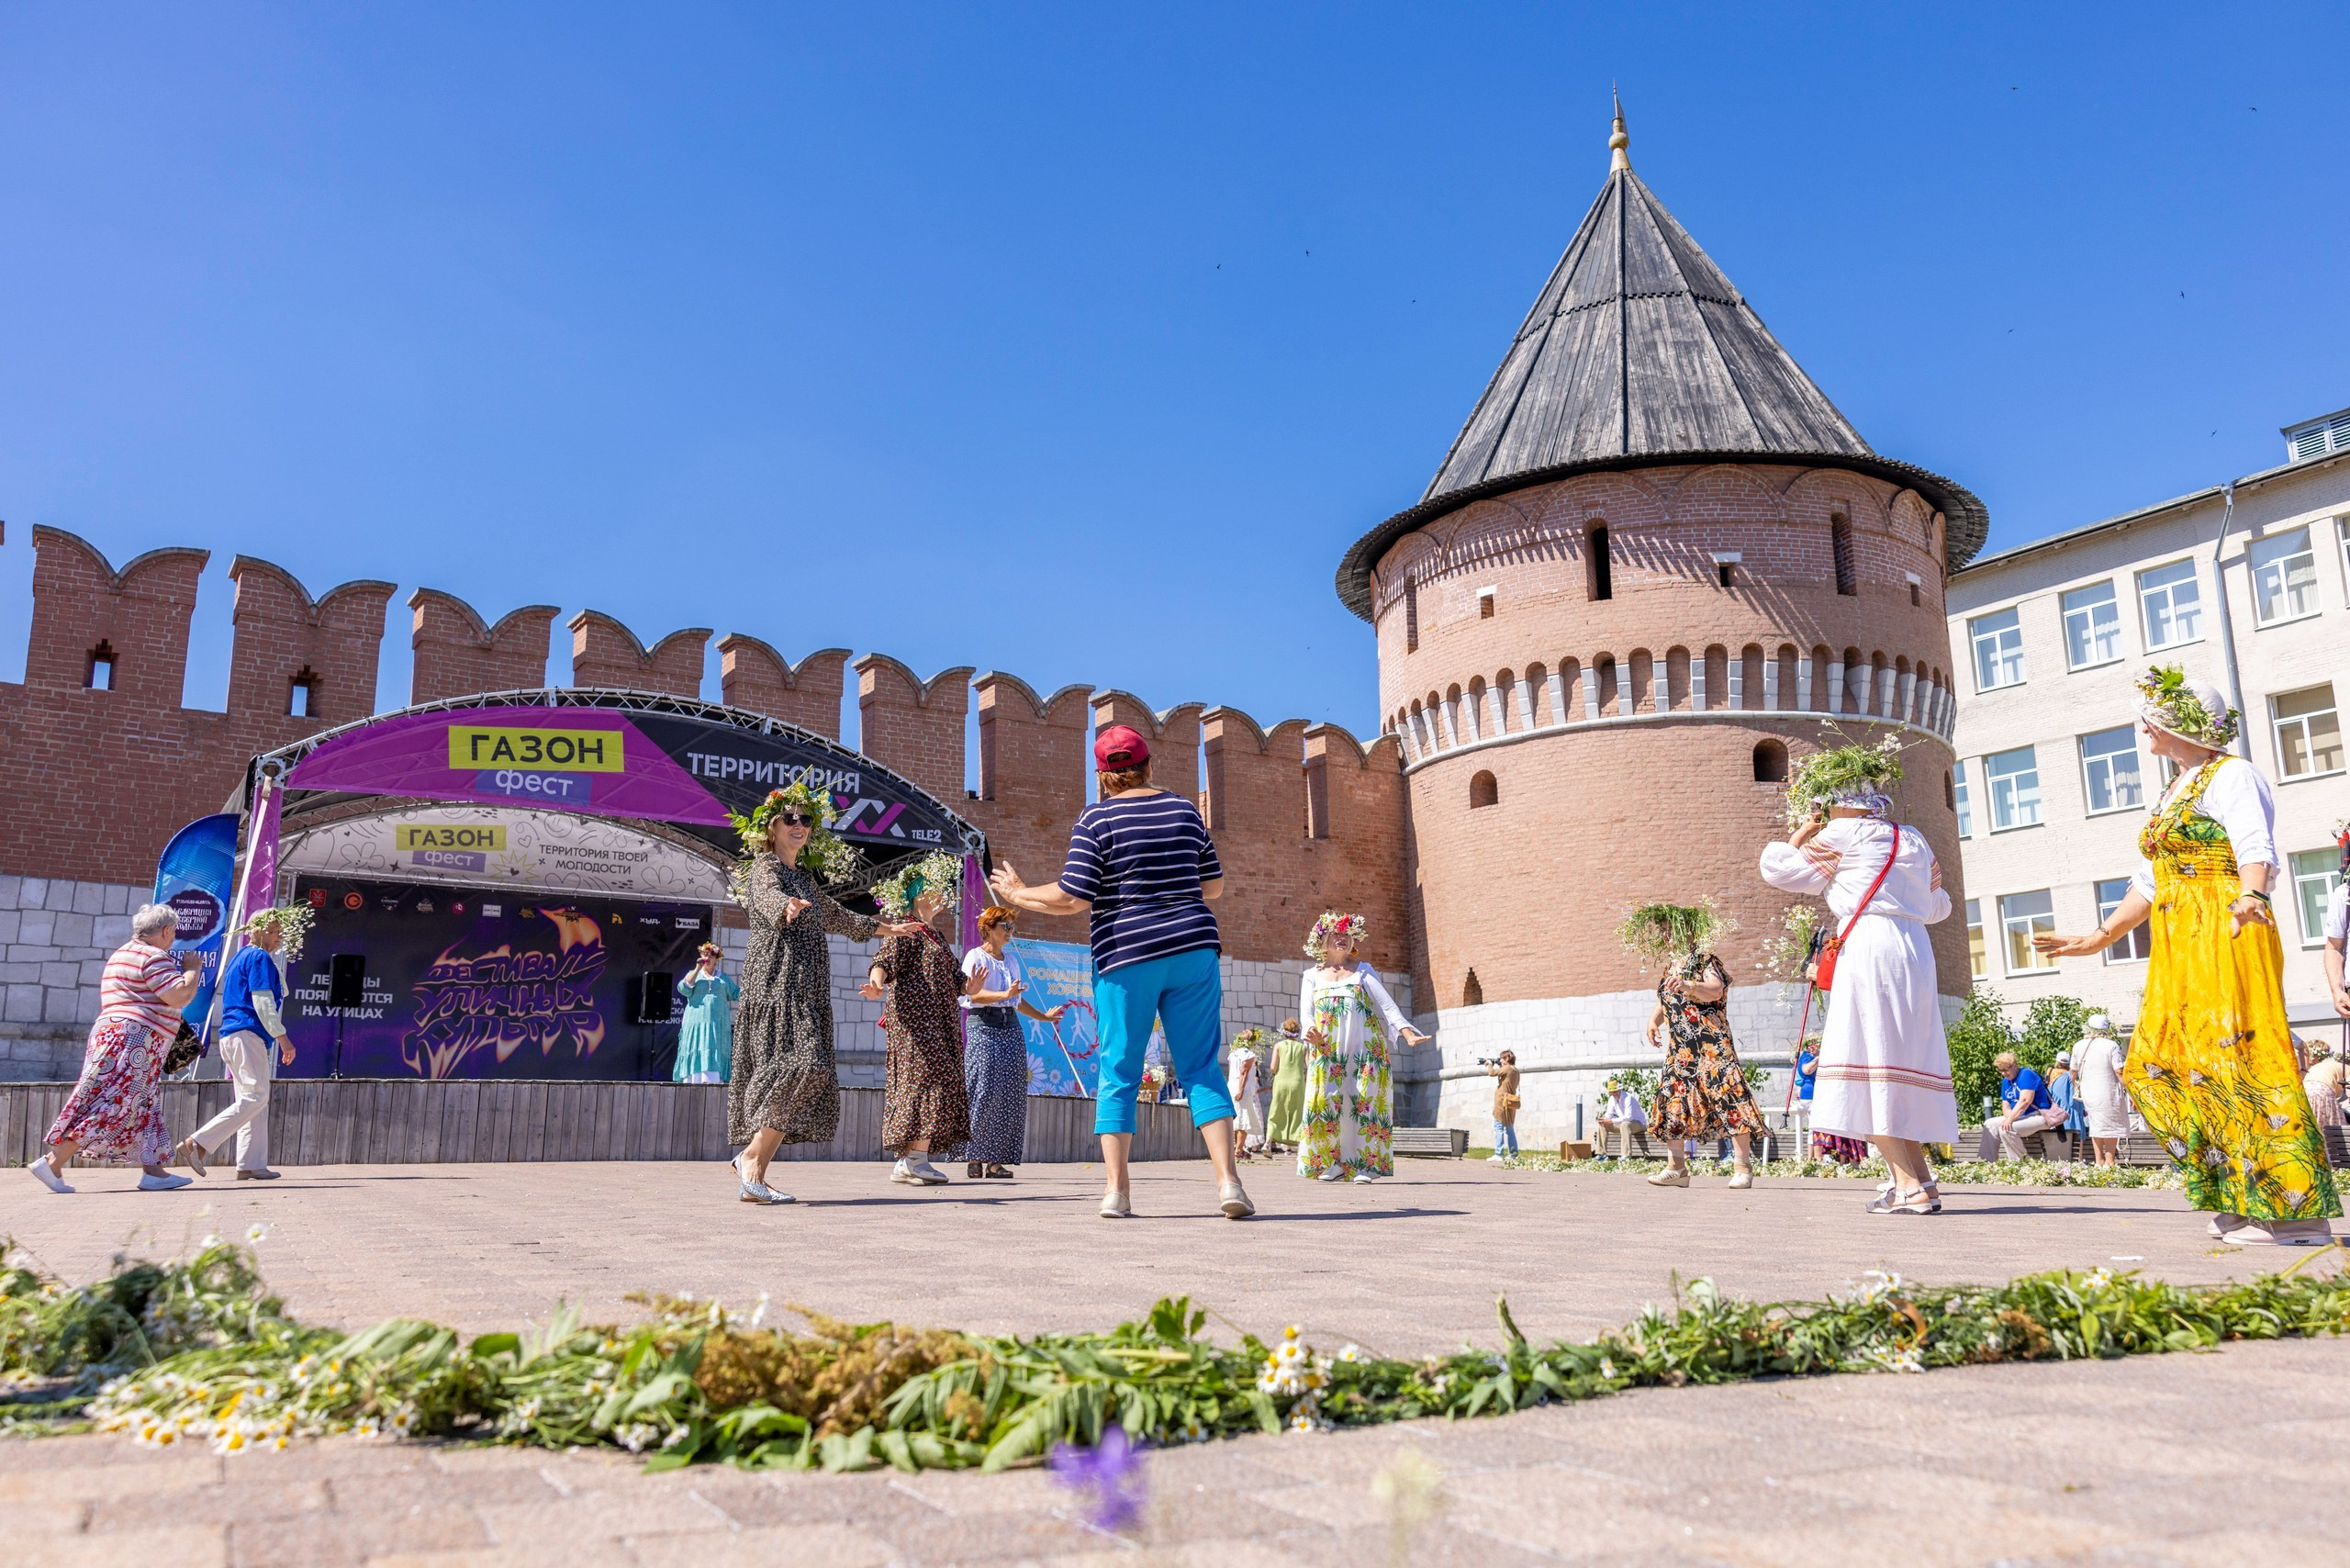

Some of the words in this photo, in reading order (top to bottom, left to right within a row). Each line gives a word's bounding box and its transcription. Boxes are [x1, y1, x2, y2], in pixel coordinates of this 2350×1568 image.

[471, 734, 604, 764] ГАЗОН
[687, 752, 860, 794] ТЕРРИТОРИЯ
[495, 769, 574, 796] фест
[409, 829, 494, 846] ГАЗОН
[912, 829, 942, 843] TELE2
[424, 850, 475, 866] фест
[540, 845, 609, 859] ТЕРРИТОРИЯ
[612, 851, 648, 862] ТВОЕЙ
[555, 860, 632, 874] МОЛОДОСТИ
[1047, 982, 1094, 998] ХОРОВ
[302, 1005, 322, 1016] НА
